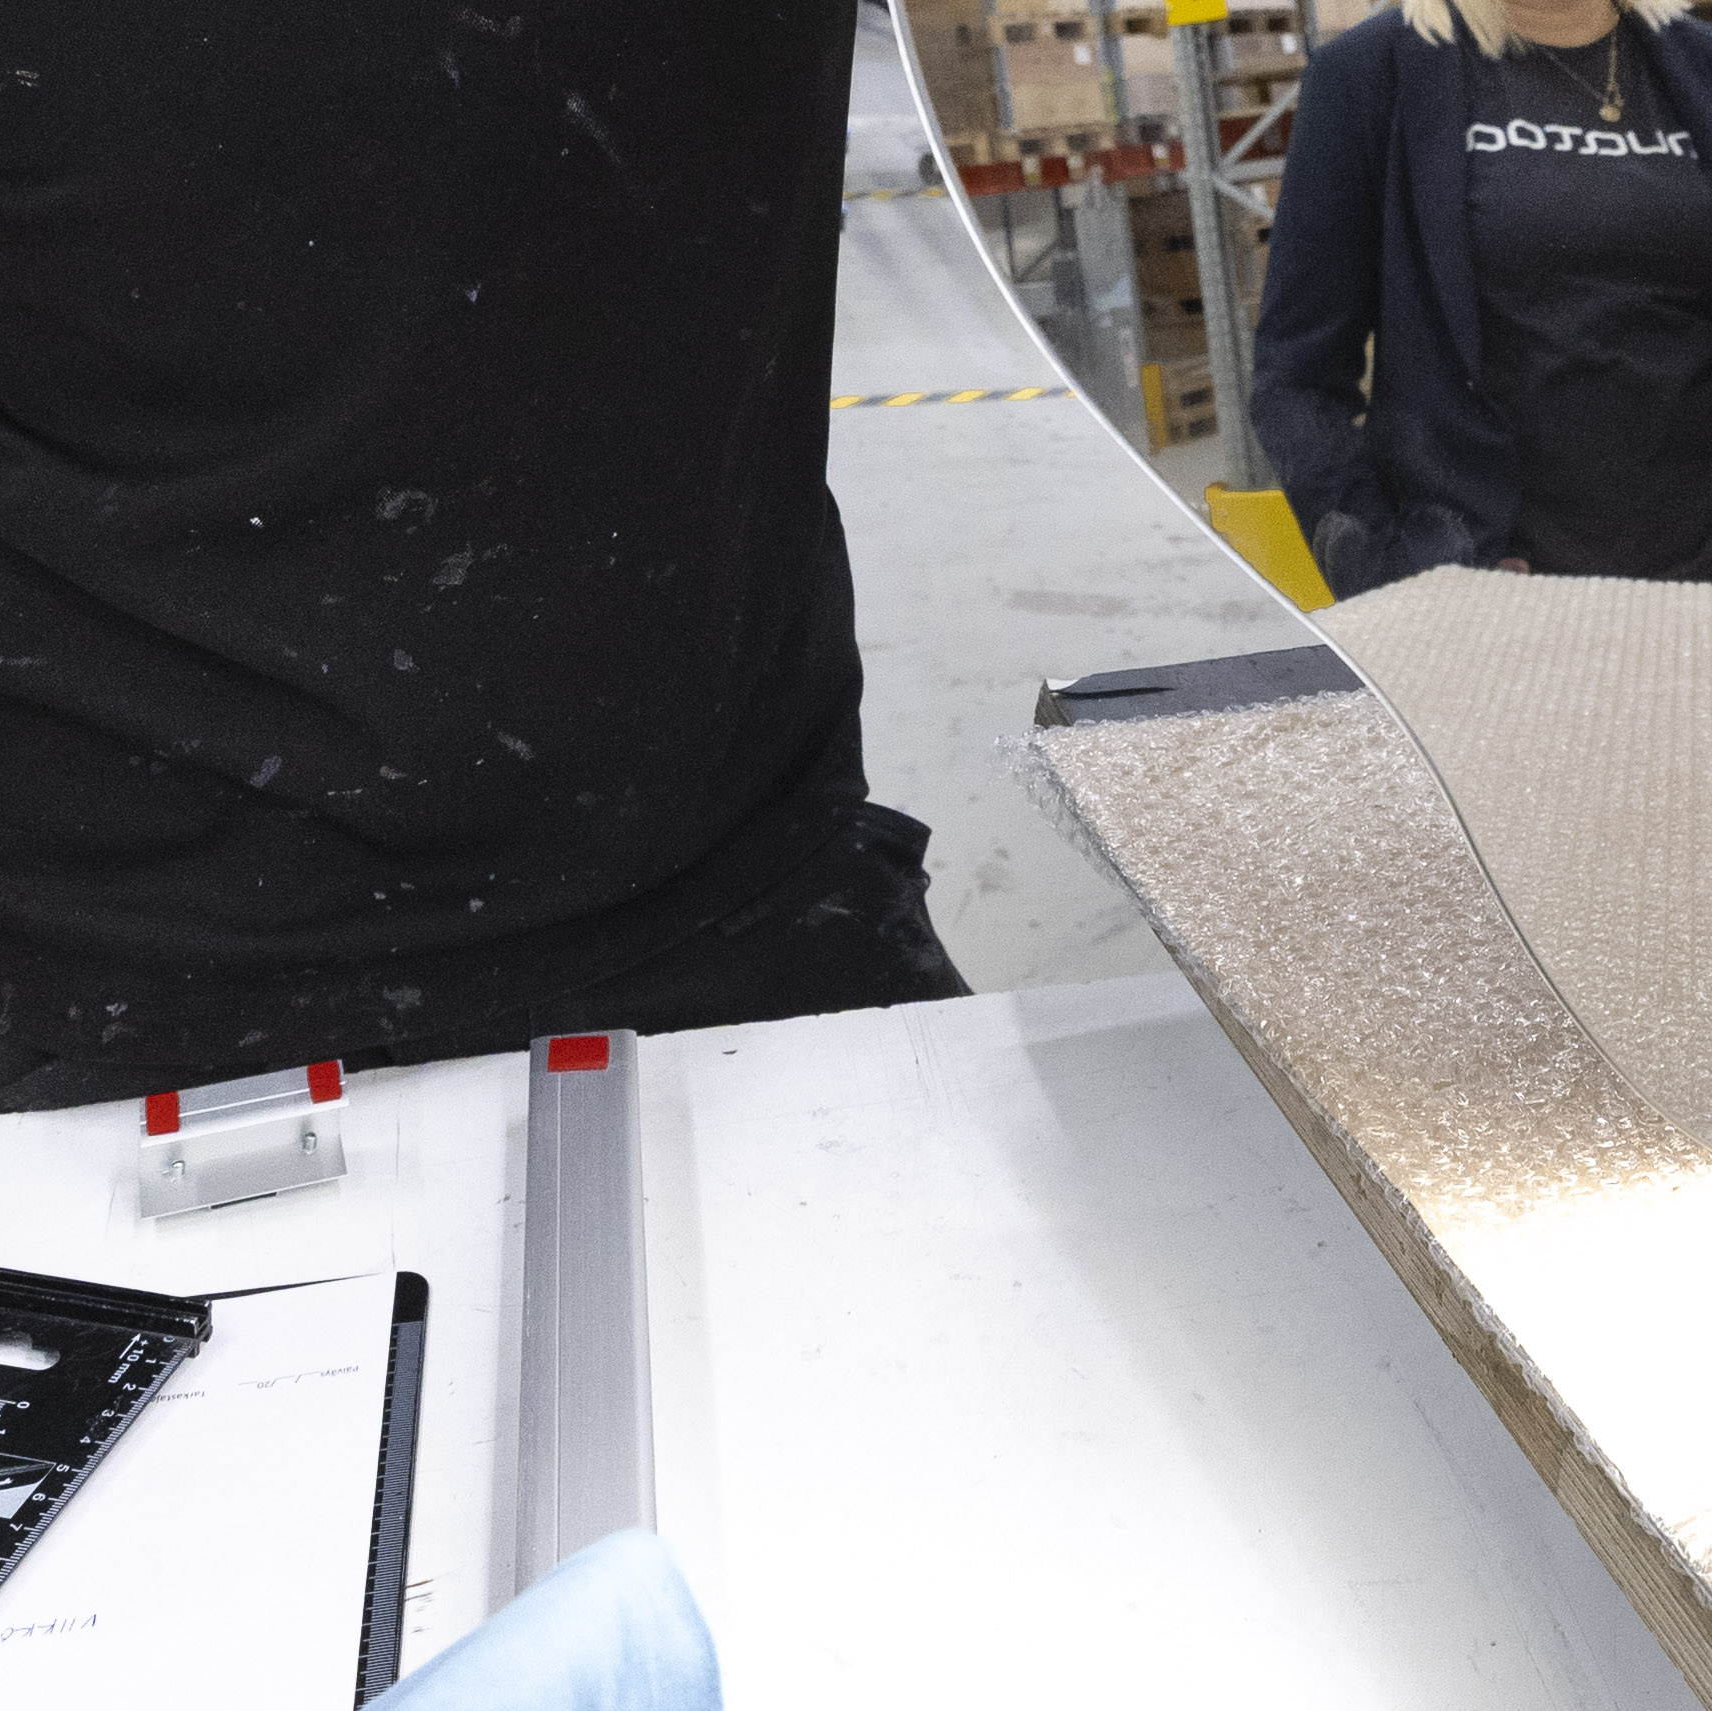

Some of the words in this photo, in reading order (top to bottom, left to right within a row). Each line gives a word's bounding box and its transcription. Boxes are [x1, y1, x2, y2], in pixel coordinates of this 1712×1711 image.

[108, 1363, 131, 1384] mm
[122, 1383, 137, 1392] 2
[16, 1401, 31, 1410] 0
[101, 1409, 115, 1418] 3
[79, 1436, 92, 1444] 4
[56, 1463, 70, 1473] 5
[32, 1493, 46, 1502] 6
[9, 1522, 23, 1532] 7
